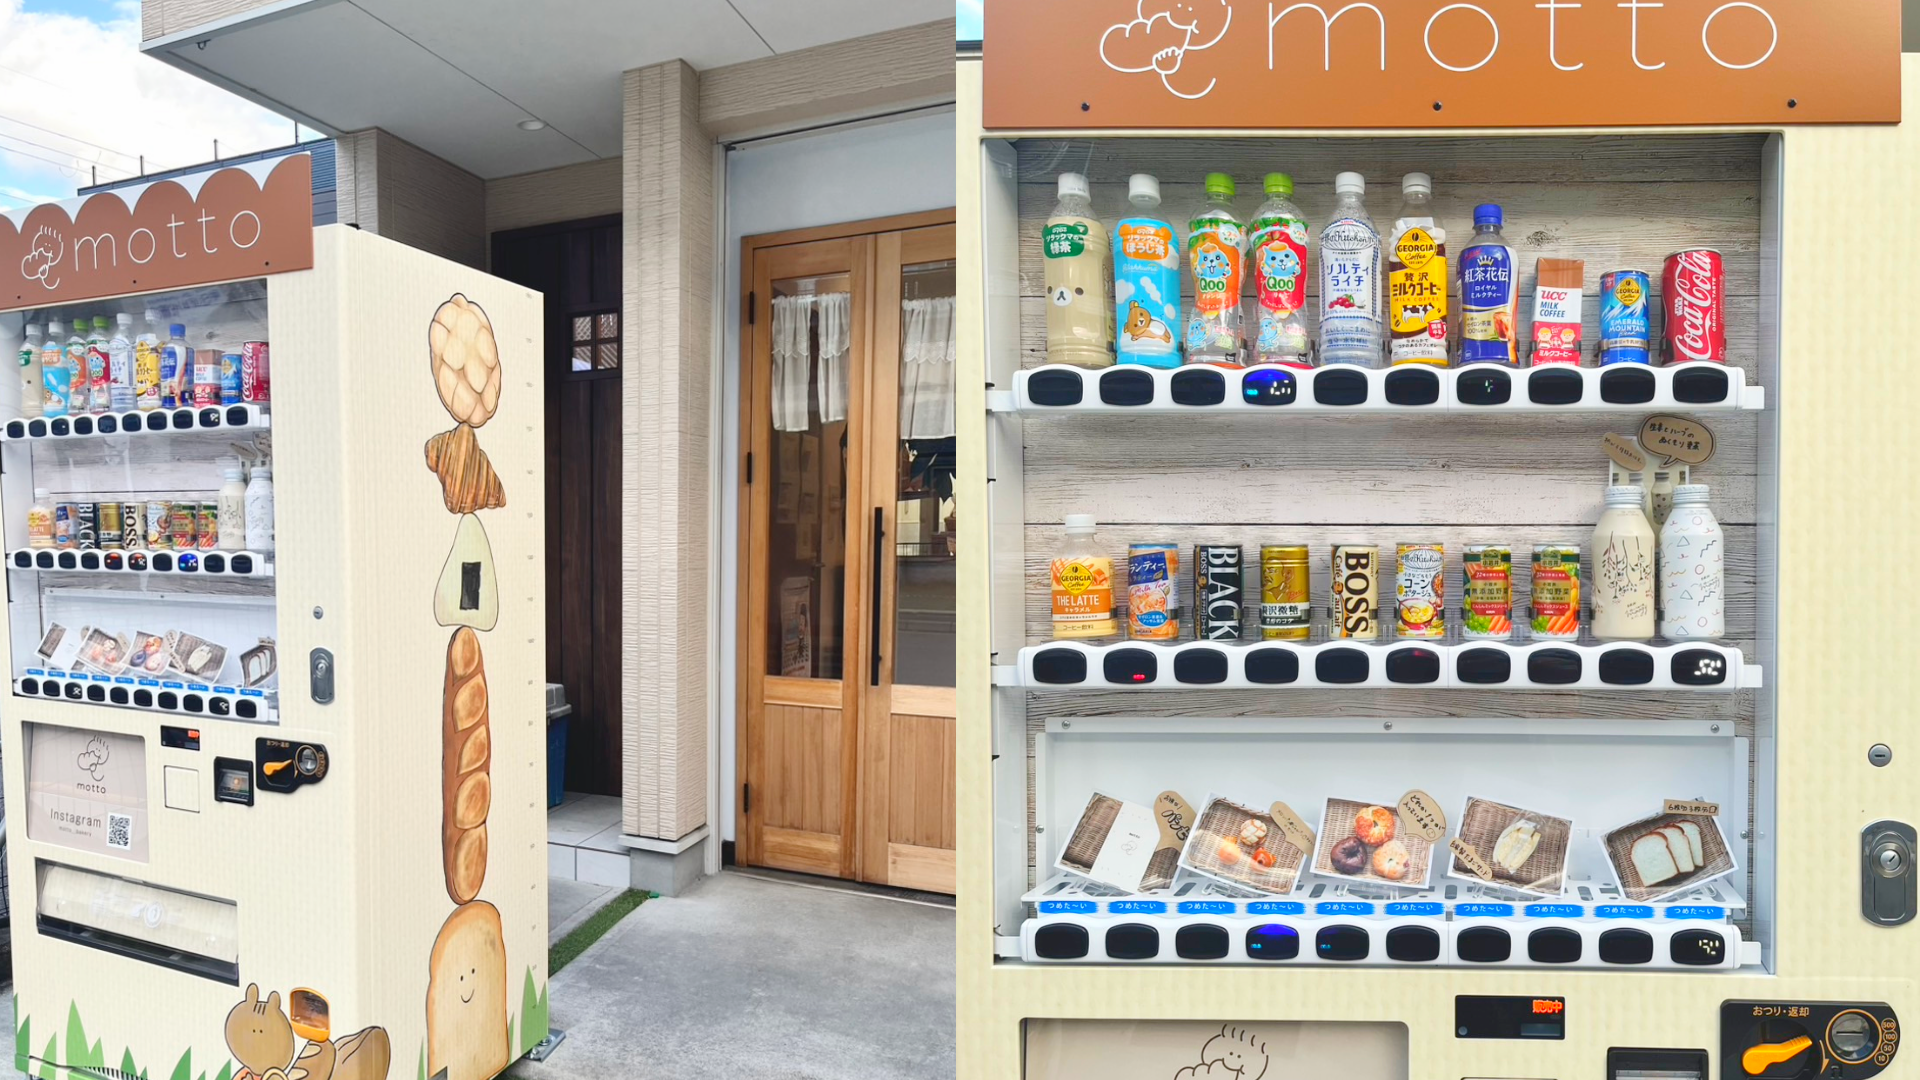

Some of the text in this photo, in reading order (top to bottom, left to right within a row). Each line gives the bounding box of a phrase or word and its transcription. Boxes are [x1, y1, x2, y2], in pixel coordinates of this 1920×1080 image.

[1269, 0, 1778, 72] motto
[74, 208, 261, 272] motto
[1050, 241, 1071, 254] 緑茶
[1126, 243, 1165, 255] ほうじ茶
[1397, 244, 1434, 252] GEORGIA
[1405, 253, 1427, 261] Coffee
[1331, 275, 1364, 287] ライチ
[1404, 272, 1429, 282] 贅沢
[1464, 267, 1509, 283] 紅茶花伝
[1200, 278, 1225, 291] Qoo
[1267, 276, 1294, 290] Qoo
[1392, 282, 1441, 296] ミルクコーヒー
[1540, 301, 1559, 309] MILK
[1675, 250, 1712, 360] Coca-Cola
[1540, 309, 1566, 318] COFFEE
[1609, 325, 1646, 333] MOUNTAIN
[79, 503, 95, 550] BLACK
[125, 505, 138, 548] BOSS
[1335, 555, 1343, 578] Café
[1404, 578, 1431, 590] コーン
[1208, 547, 1239, 641] BLACK
[1345, 551, 1370, 634] BOSS
[1403, 589, 1432, 598] ポタージュ
[1056, 594, 1100, 606] THE LATTE
[76, 782, 106, 794] motto
[50, 808, 101, 828] Instagram
[1532, 999, 1563, 1014] 販売中
[1752, 1006, 1810, 1017] おつり・返却
[1883, 1021, 1895, 1029] 500
[1883, 1044, 1892, 1052] 50
